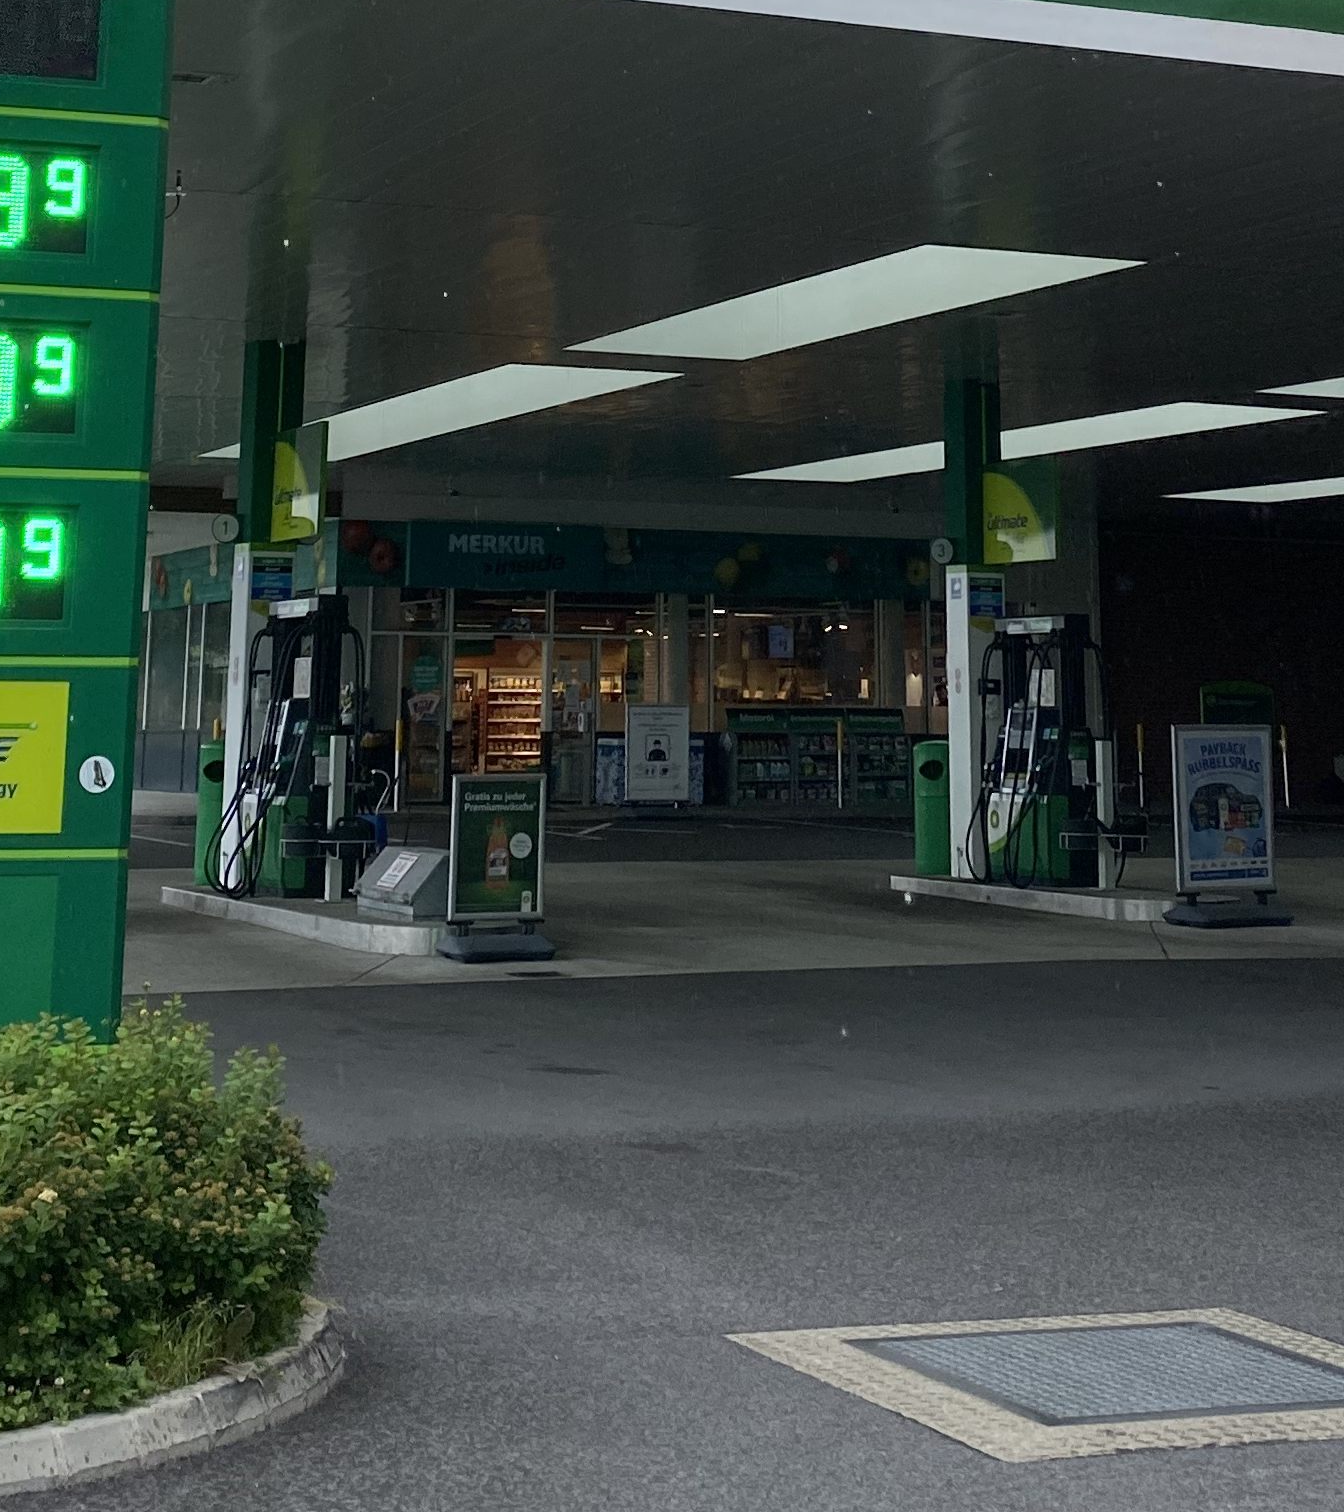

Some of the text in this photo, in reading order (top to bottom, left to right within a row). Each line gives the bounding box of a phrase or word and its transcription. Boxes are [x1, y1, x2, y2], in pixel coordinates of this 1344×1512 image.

[447, 533, 545, 555] MERKUR
[1199, 742, 1247, 756] PAYBACK
[464, 791, 491, 802] Gratis
[492, 793, 503, 801] zu
